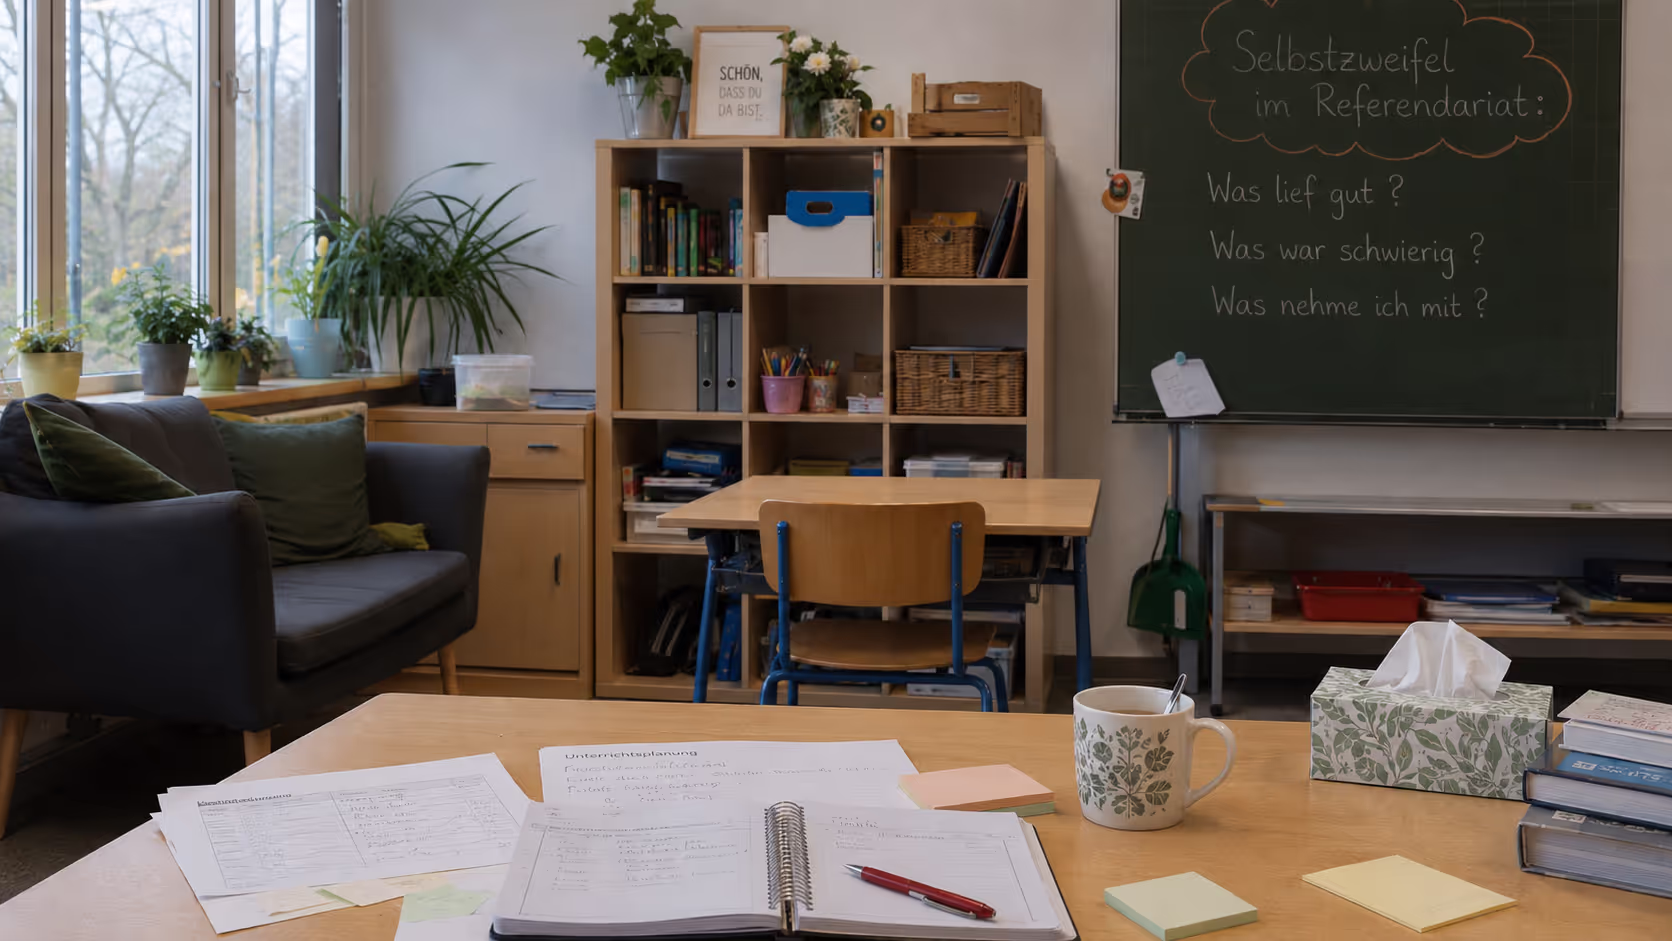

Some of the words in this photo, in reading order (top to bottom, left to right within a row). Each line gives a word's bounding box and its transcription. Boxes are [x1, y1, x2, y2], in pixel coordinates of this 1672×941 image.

[1232, 29, 1455, 84] Selbstzweifel
[719, 86, 745, 99] DASS
[749, 86, 762, 99] DU
[1255, 90, 1290, 118] im
[718, 104, 733, 117] DA
[1207, 171, 1261, 203] Was
[1275, 174, 1316, 209] lief
[1330, 177, 1375, 220] gut
[1210, 230, 1265, 260] Was
[1279, 241, 1326, 260] war
[1339, 232, 1455, 279] schwierig
[1211, 285, 1266, 316] Was
[1280, 287, 1360, 317] nehme
[1375, 289, 1409, 317] ich
[1421, 292, 1462, 317] mit
[564, 750, 698, 760] Unterrichtsplanung
